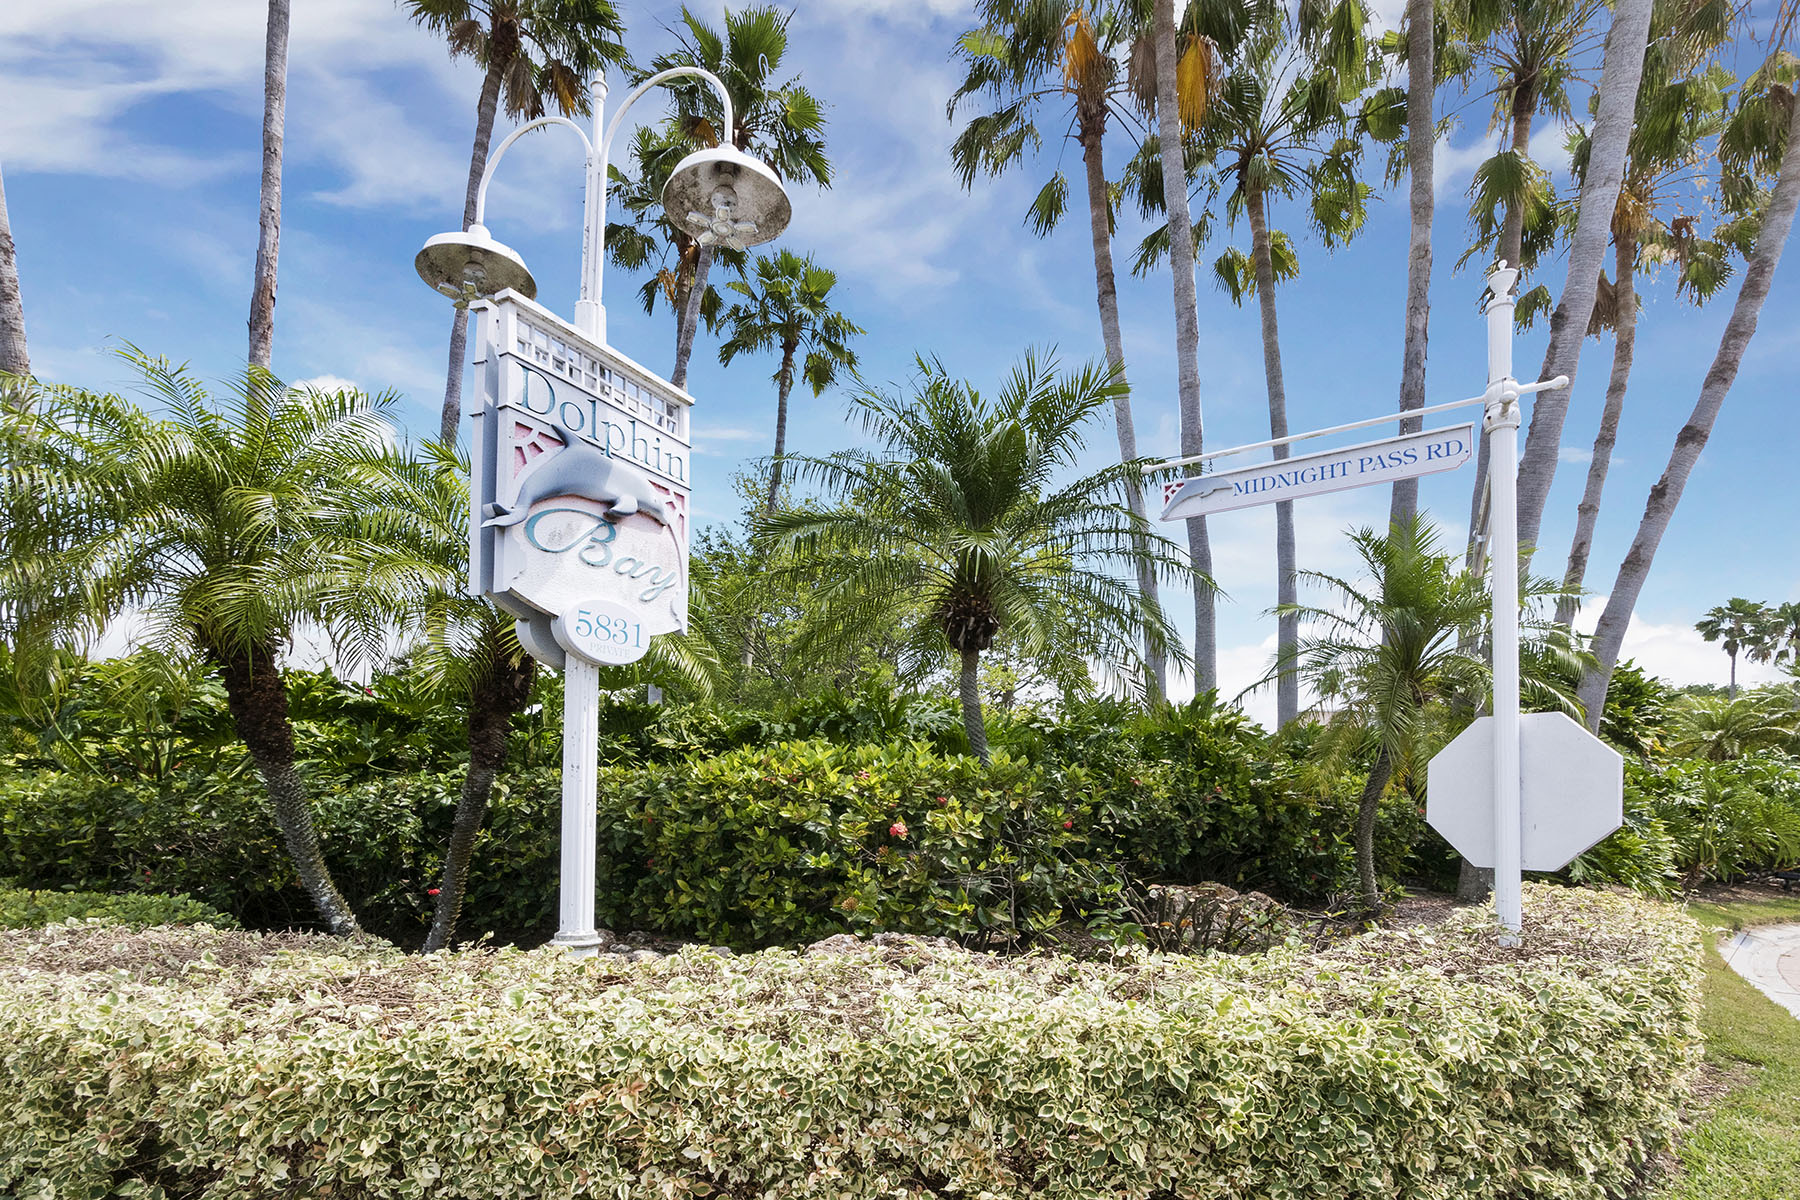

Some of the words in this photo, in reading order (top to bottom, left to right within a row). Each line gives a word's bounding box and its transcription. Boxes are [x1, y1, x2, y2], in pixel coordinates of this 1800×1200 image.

[516, 363, 685, 482] Dolphin
[1233, 460, 1352, 496] MIDNIGHT
[1359, 448, 1417, 473] PASS
[1426, 439, 1469, 461] RD.
[525, 508, 676, 602] Bay
[575, 609, 642, 648] 5831
[590, 641, 631, 658] PRIVATE
